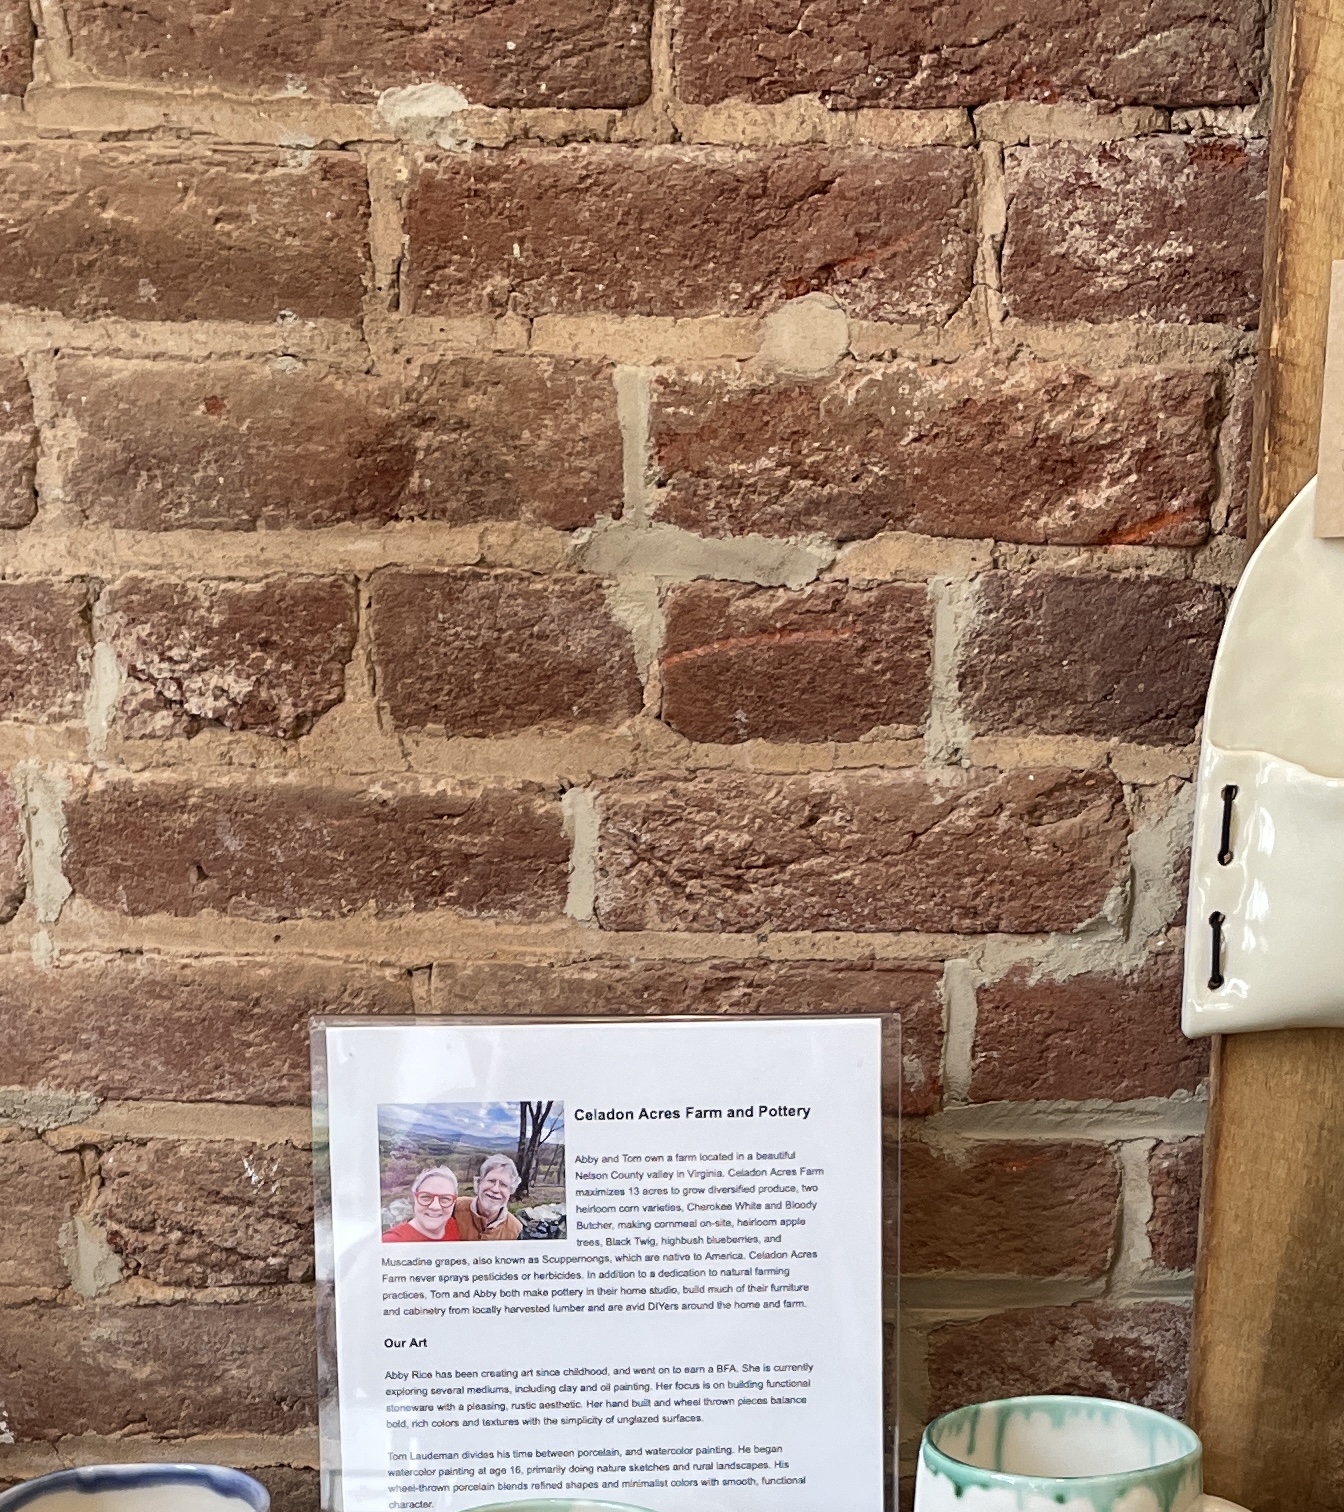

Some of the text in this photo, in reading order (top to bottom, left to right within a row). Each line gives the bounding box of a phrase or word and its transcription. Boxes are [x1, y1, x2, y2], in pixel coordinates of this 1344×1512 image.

[573, 1104, 811, 1121] Celadon Acres Farm and Pottery
[573, 1150, 796, 1166] Abby and Tom own a farm located in a beautiful
[574, 1165, 824, 1181] Nelson County valley in Virginia. Celadon Acres Farm
[574, 1187, 625, 1196] maximizes
[641, 1187, 669, 1196] acres
[670, 1185, 680, 1195] to
[681, 1186, 706, 1197] grow
[707, 1183, 756, 1194] diversified
[757, 1183, 799, 1195] produce,
[800, 1183, 819, 1192] two
[575, 1199, 818, 1214] heirloom corn varieties, Cherokee White and Bloody
[575, 1216, 806, 1231] Butcher, making cornmeal on-site, heirloom apple
[575, 1233, 782, 1248] trees, Black Twig, highbush blueberries, and
[380, 1248, 818, 1268] Muscadine grapes, also known as Scuppernongs, which are native to America. Celadon Acres
[383, 1337, 427, 1348] Our Art
[385, 1412, 704, 1429] bold, rich colors and textures with the simplicity of unglazed surfaces.
[388, 1451, 407, 1461] Tom
[460, 1449, 495, 1460] divides
[495, 1449, 511, 1459] his
[511, 1448, 533, 1459] time
[534, 1448, 575, 1458] between
[576, 1447, 622, 1459] porcelain,
[624, 1446, 643, 1456] and
[643, 1445, 694, 1456] watercolor
[694, 1444, 735, 1456] painting.
[736, 1444, 751, 1454] He
[752, 1444, 783, 1455] began
